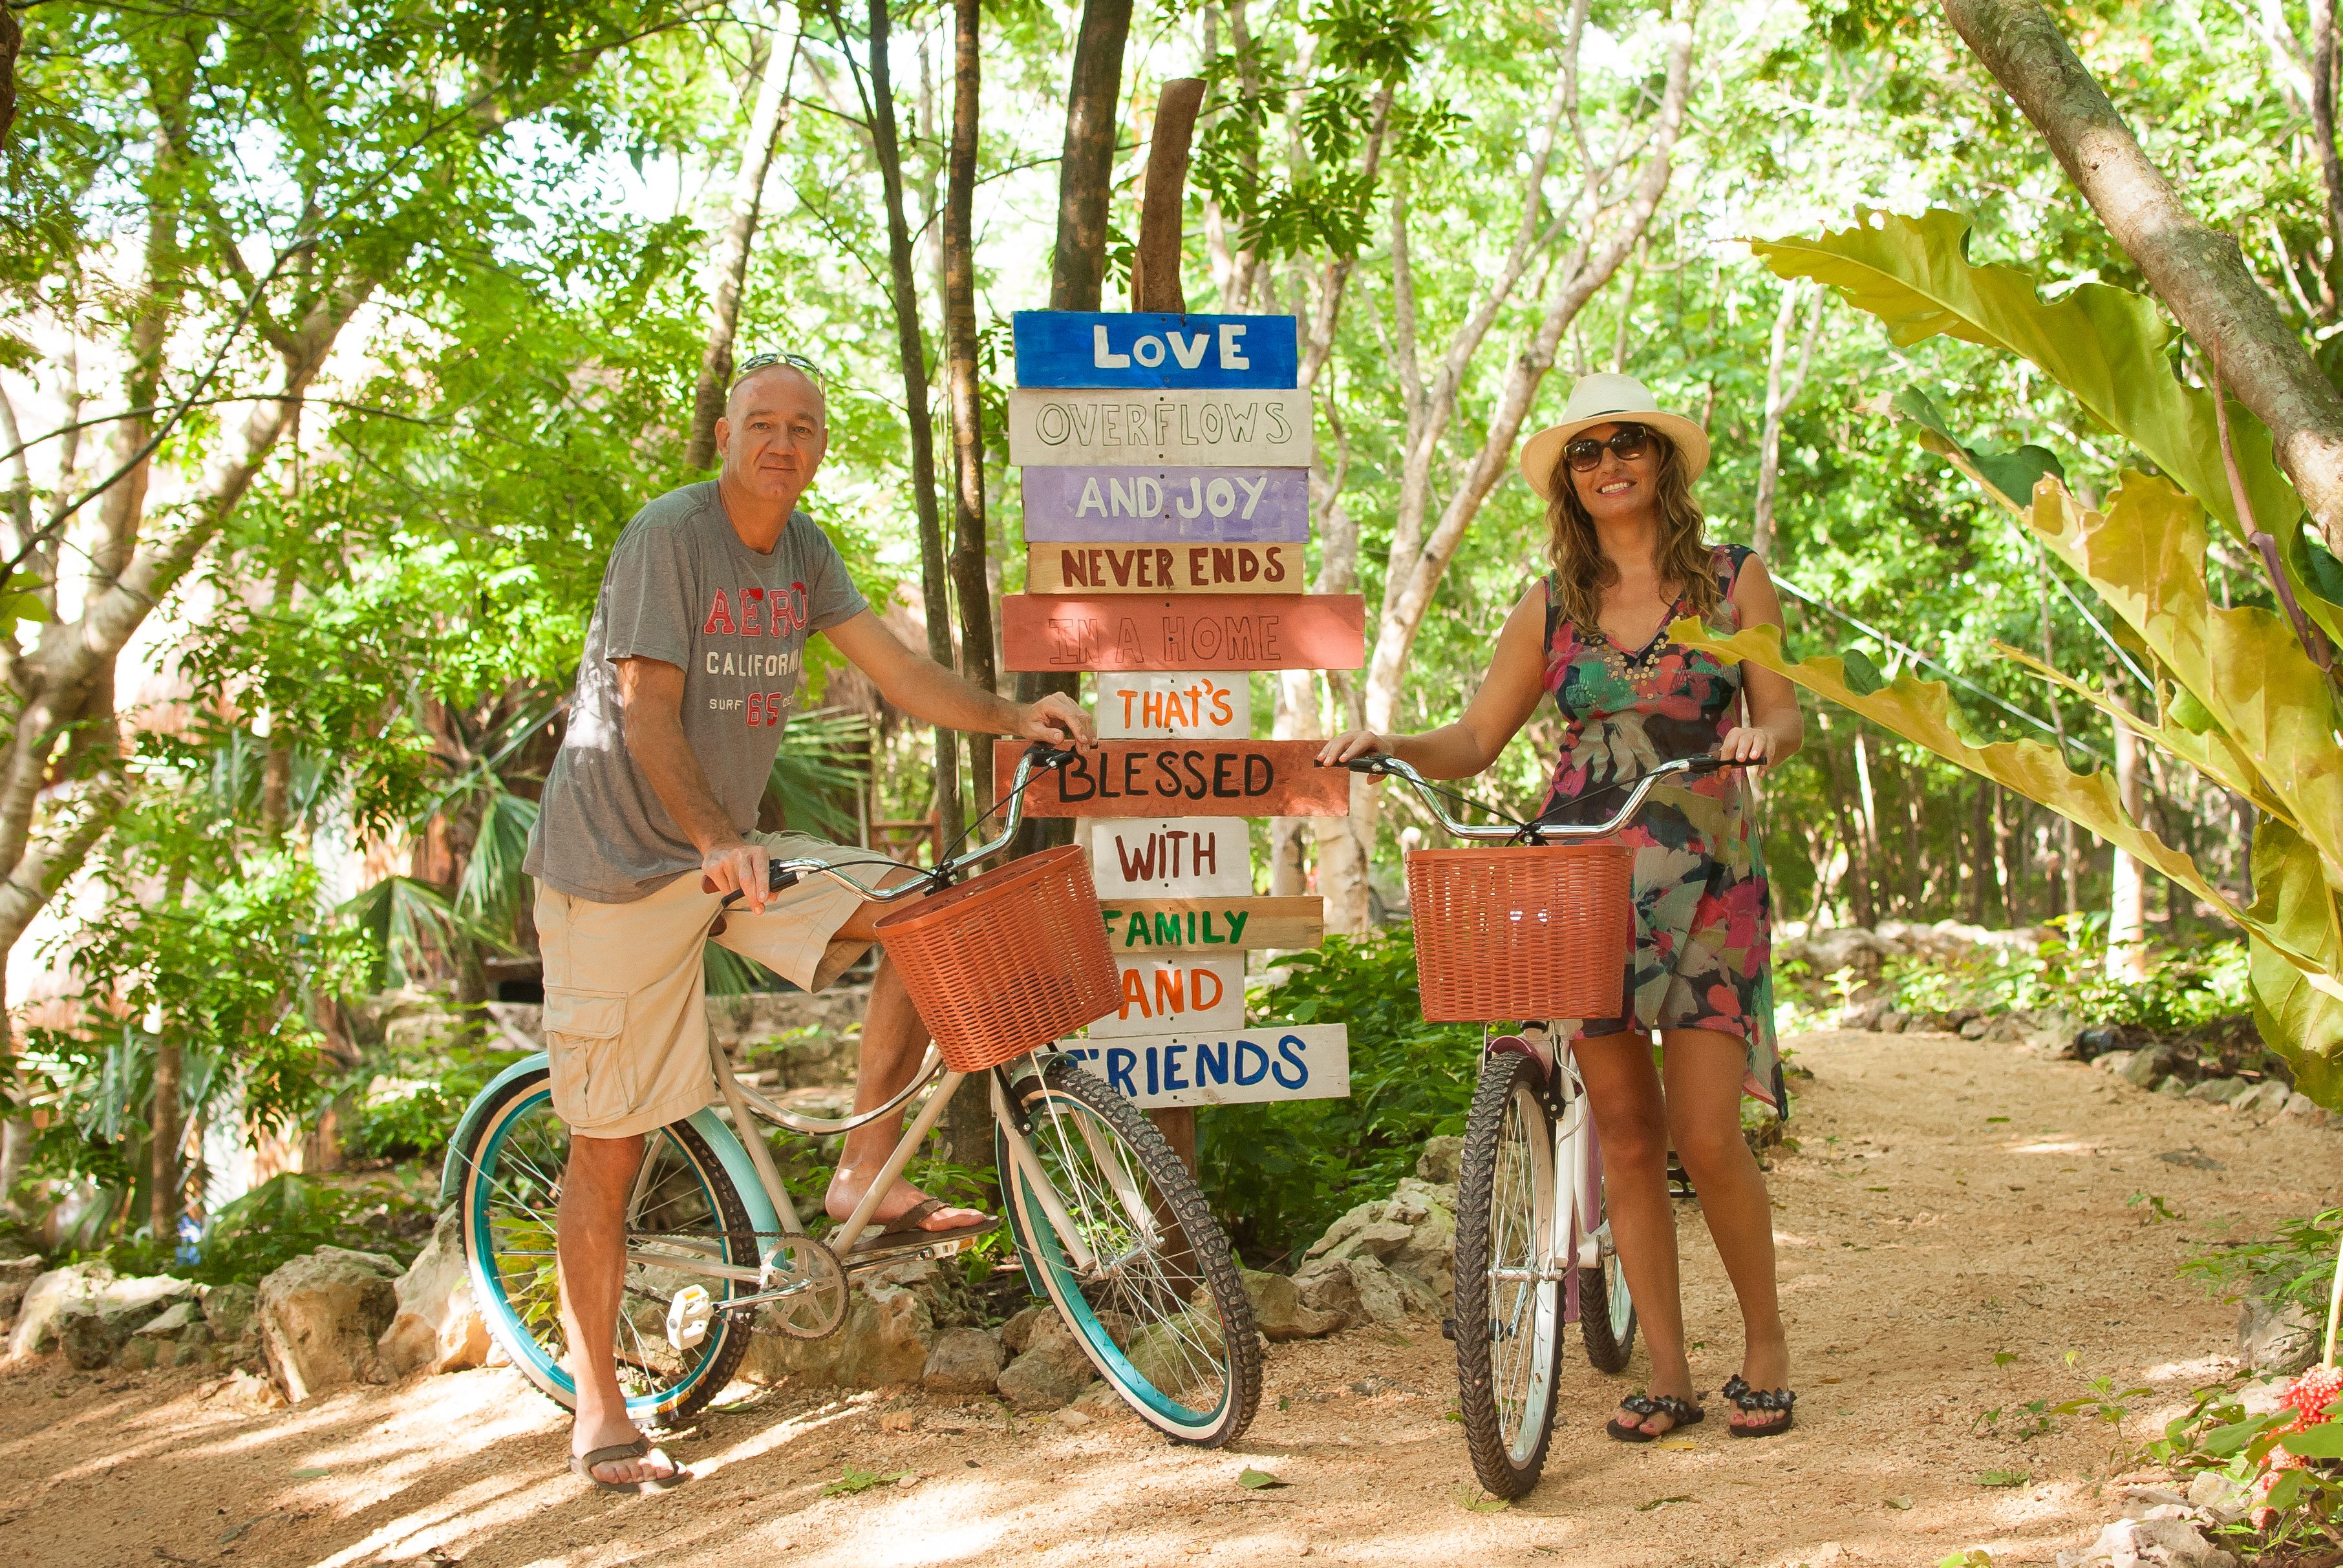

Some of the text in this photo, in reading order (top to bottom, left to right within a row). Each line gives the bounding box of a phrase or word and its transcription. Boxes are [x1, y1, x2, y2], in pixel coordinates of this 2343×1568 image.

[1093, 324, 1250, 370] LOVE
[1036, 403, 1292, 447] OVERFLOWS
[1075, 477, 1268, 520] AND JOY
[1060, 546, 1285, 588] NEVER ENDS
[703, 582, 808, 638] AERO
[1048, 616, 1281, 665] IN A HOME
[709, 699, 744, 711] SURF
[746, 692, 782, 727] 65
[1058, 750, 1274, 803] BLESSED
[1115, 830, 1216, 882] WITH
[1102, 910, 1249, 948] FAMILY
[1118, 968, 1224, 1021] AND
